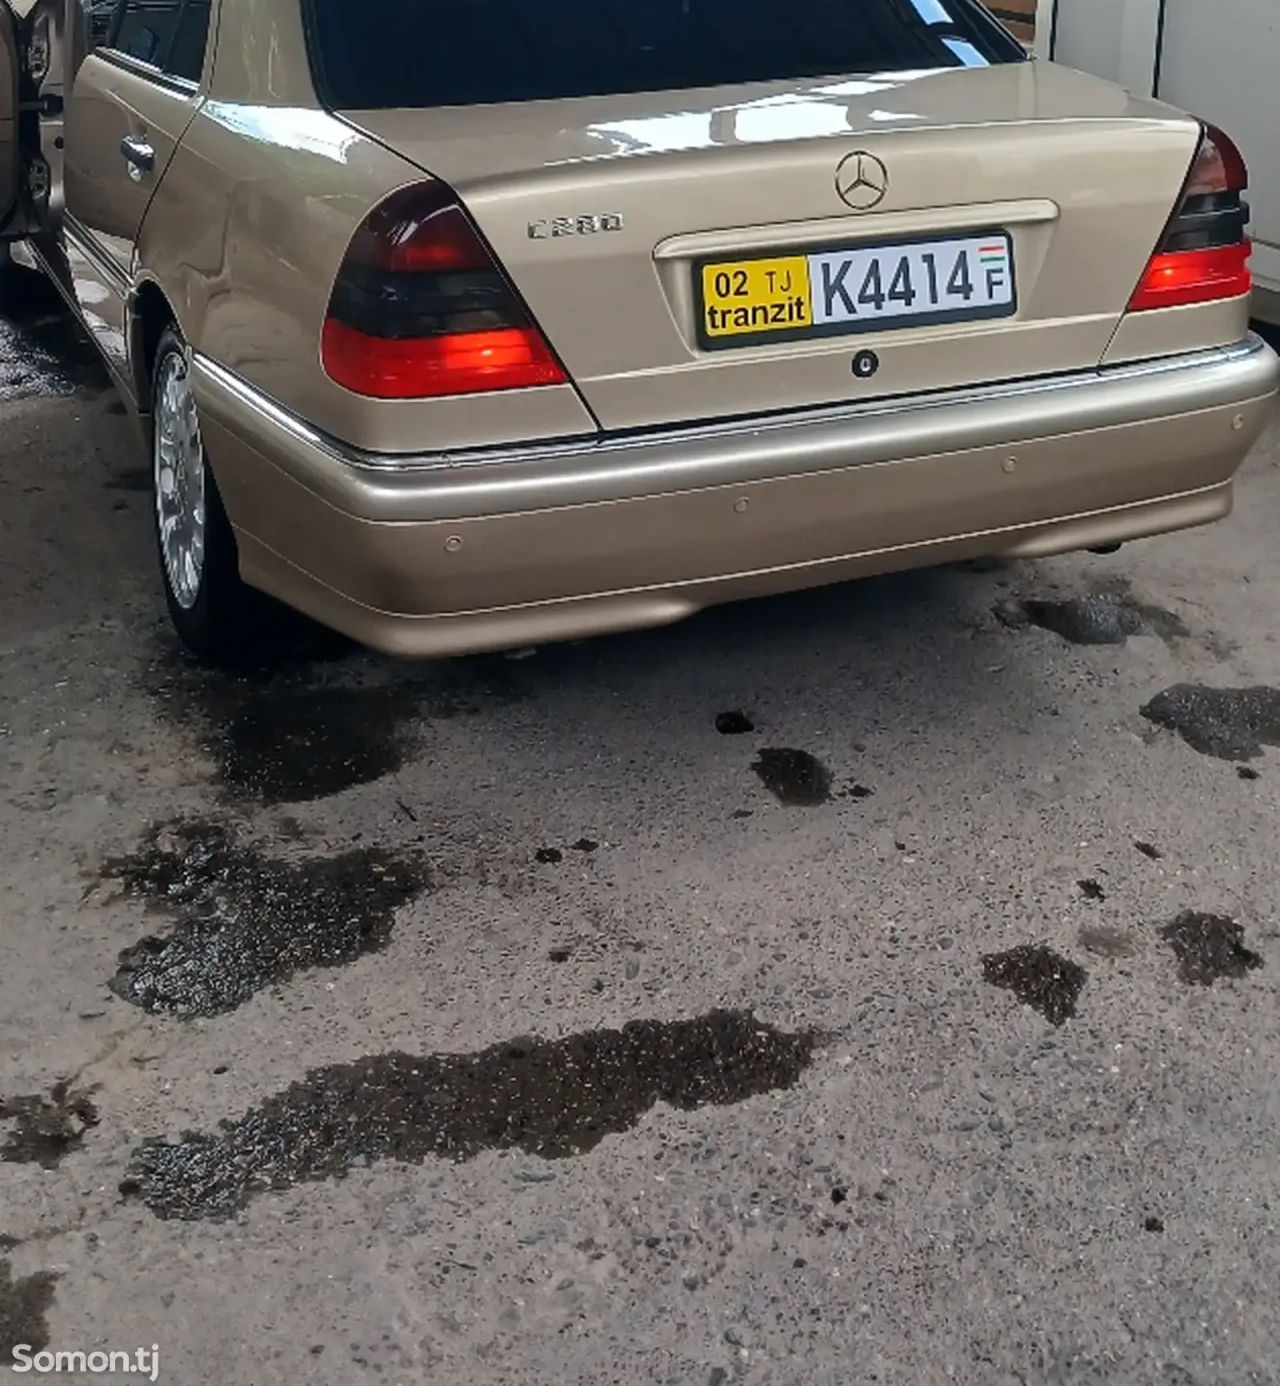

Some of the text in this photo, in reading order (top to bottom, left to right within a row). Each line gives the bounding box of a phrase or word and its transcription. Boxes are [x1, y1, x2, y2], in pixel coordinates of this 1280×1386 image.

[527, 212, 623, 239] C280
[715, 270, 792, 298] 02 TJ
[821, 250, 974, 316] K4414
[986, 267, 1004, 300] F
[707, 296, 806, 329] tranzit
